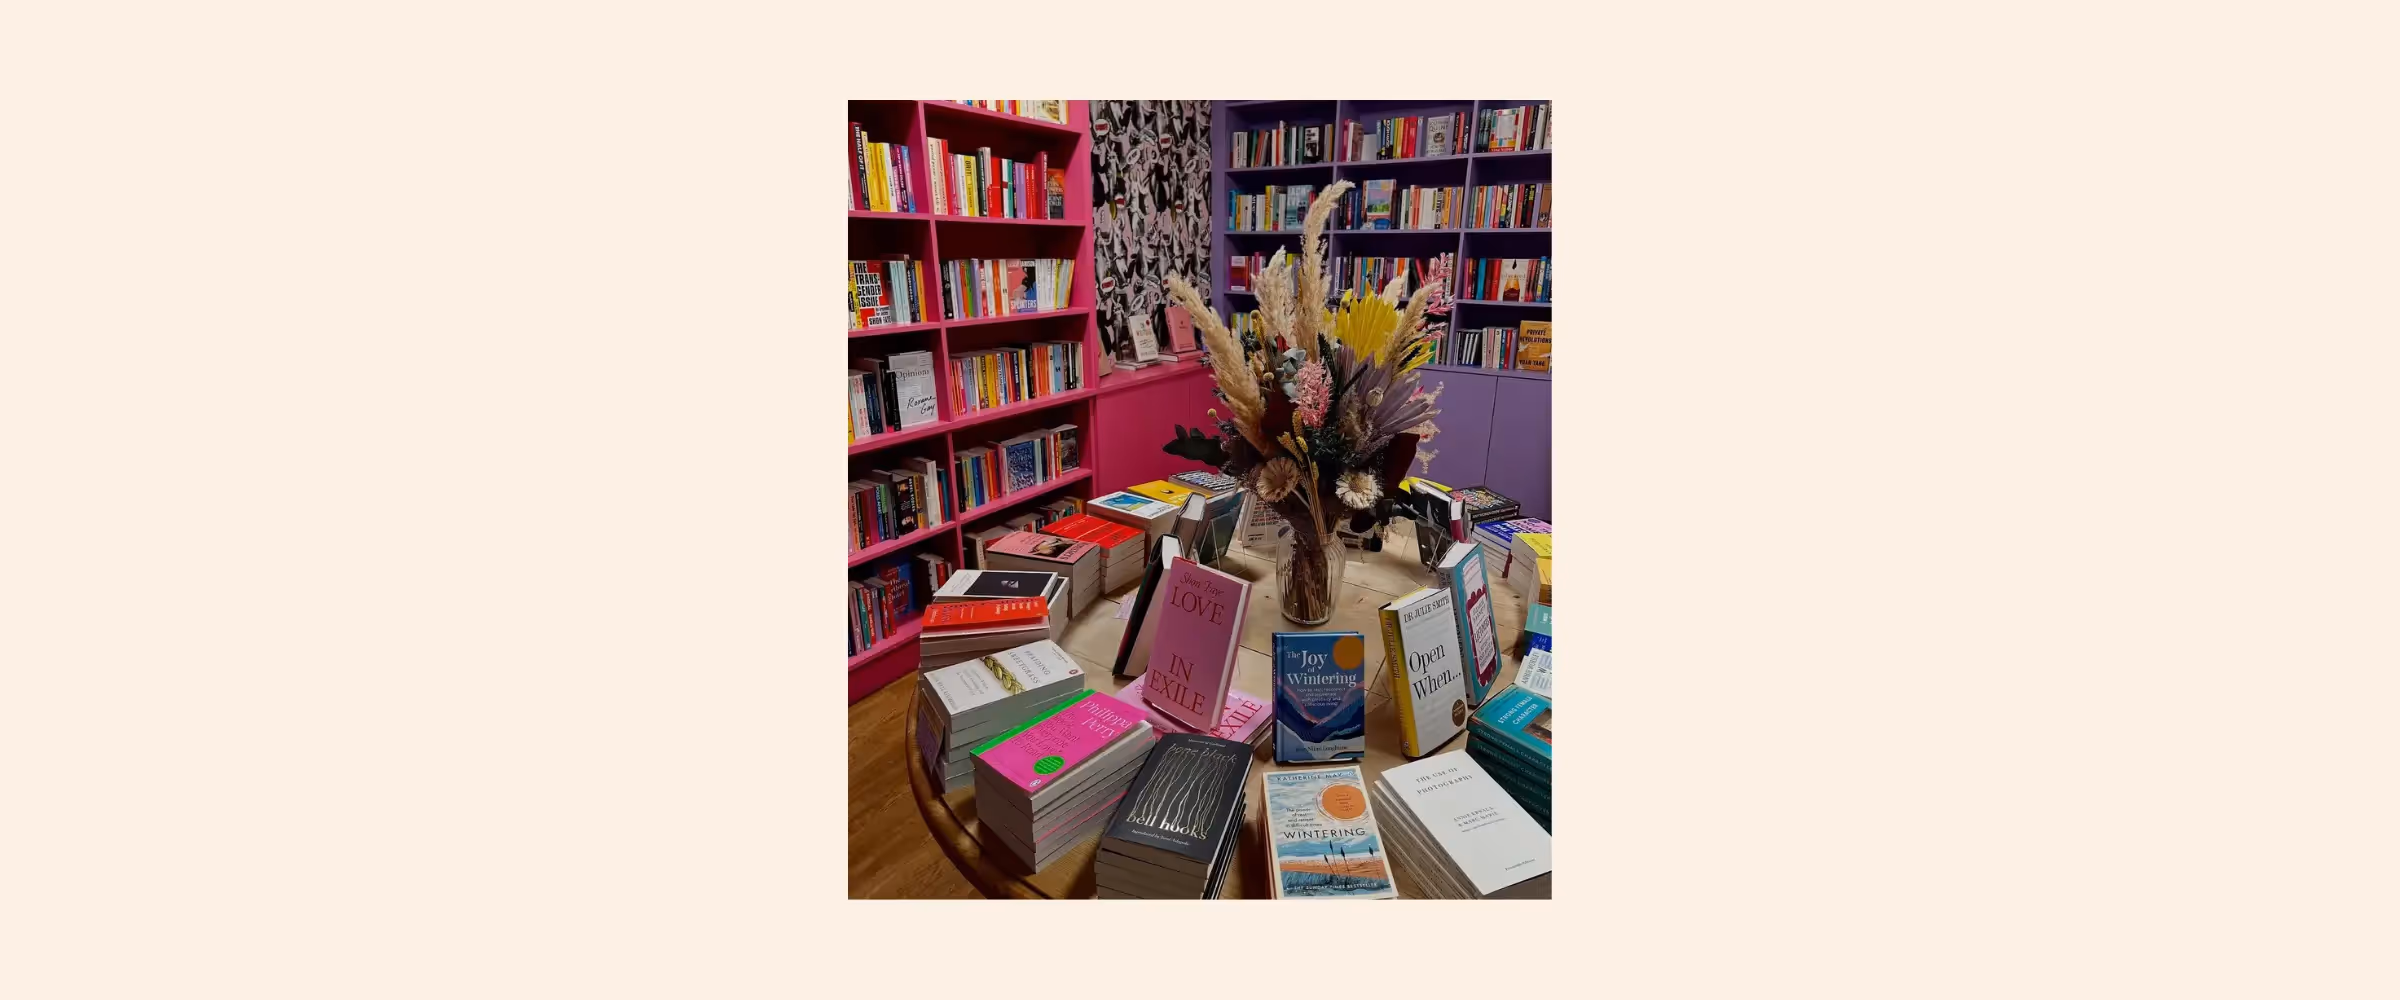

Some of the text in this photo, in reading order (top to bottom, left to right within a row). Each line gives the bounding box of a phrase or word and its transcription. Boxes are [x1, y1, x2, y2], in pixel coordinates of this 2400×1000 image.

[854, 263, 866, 273] THE
[856, 274, 880, 285] TRANS-
[857, 285, 882, 296] GENDER
[859, 297, 879, 307] ISSUE
[896, 369, 929, 381] Opinions
[921, 404, 935, 416] Gay
[1204, 579, 1224, 597] Faye
[1170, 586, 1224, 626] LOVE
[1404, 595, 1450, 623] DR JULIE SMITH
[1169, 653, 1195, 681] IN
[1301, 650, 1328, 670] Joy
[1410, 644, 1445, 674] Open
[1287, 672, 1356, 687] Wintering
[1413, 669, 1461, 700] When...
[1149, 669, 1206, 716] EXILE
[1080, 701, 1132, 729] Philippa
[1498, 696, 1533, 724] STRONG FEMALE
[1513, 703, 1538, 725] CHARACTER
[1081, 718, 1116, 738] Perry
[1167, 743, 1239, 764] bone black
[1416, 774, 1431, 783] THE
[1433, 770, 1448, 778] USE
[1417, 775, 1473, 795] PHOTOGRAPHY
[1126, 813, 1208, 840] bell hooks
[1283, 828, 1366, 839] WINTERING
